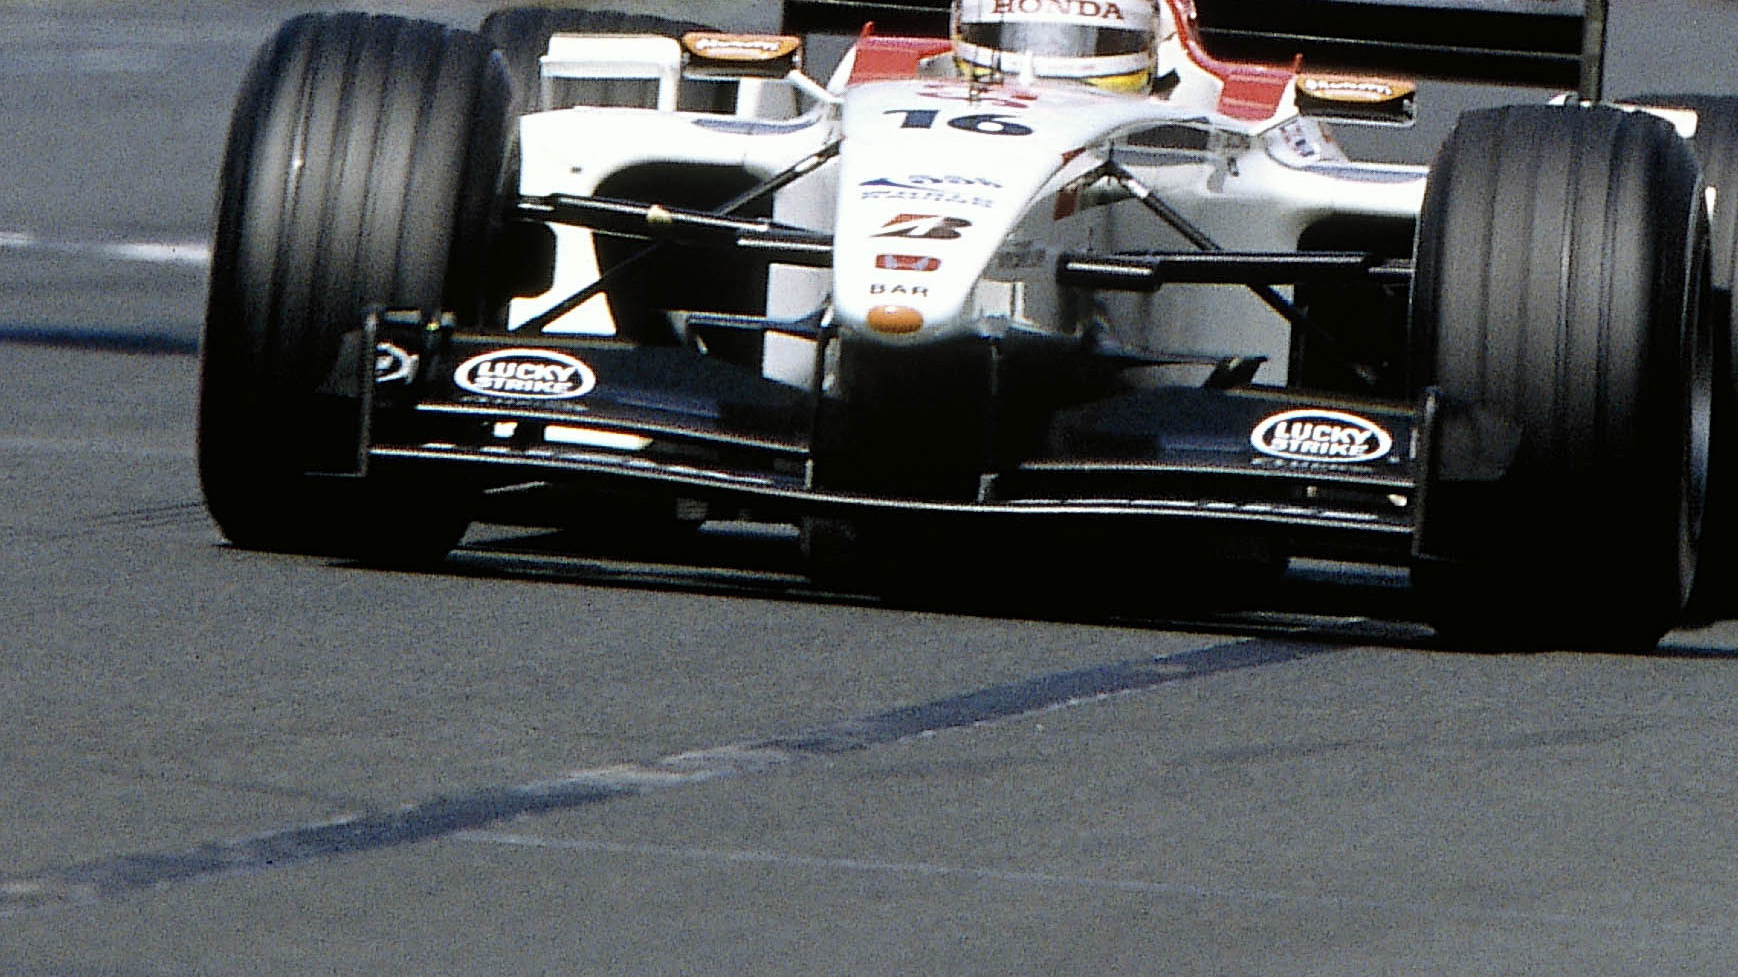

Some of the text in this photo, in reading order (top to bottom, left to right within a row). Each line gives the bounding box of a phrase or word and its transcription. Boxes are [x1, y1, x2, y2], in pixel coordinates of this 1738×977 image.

[883, 109, 1034, 136] 16
[870, 283, 929, 297] BAR
[476, 361, 576, 381] LUCKY
[473, 376, 572, 395] STRIKE
[1273, 421, 1373, 444] LUCKY
[1269, 437, 1369, 456] STRIKE
